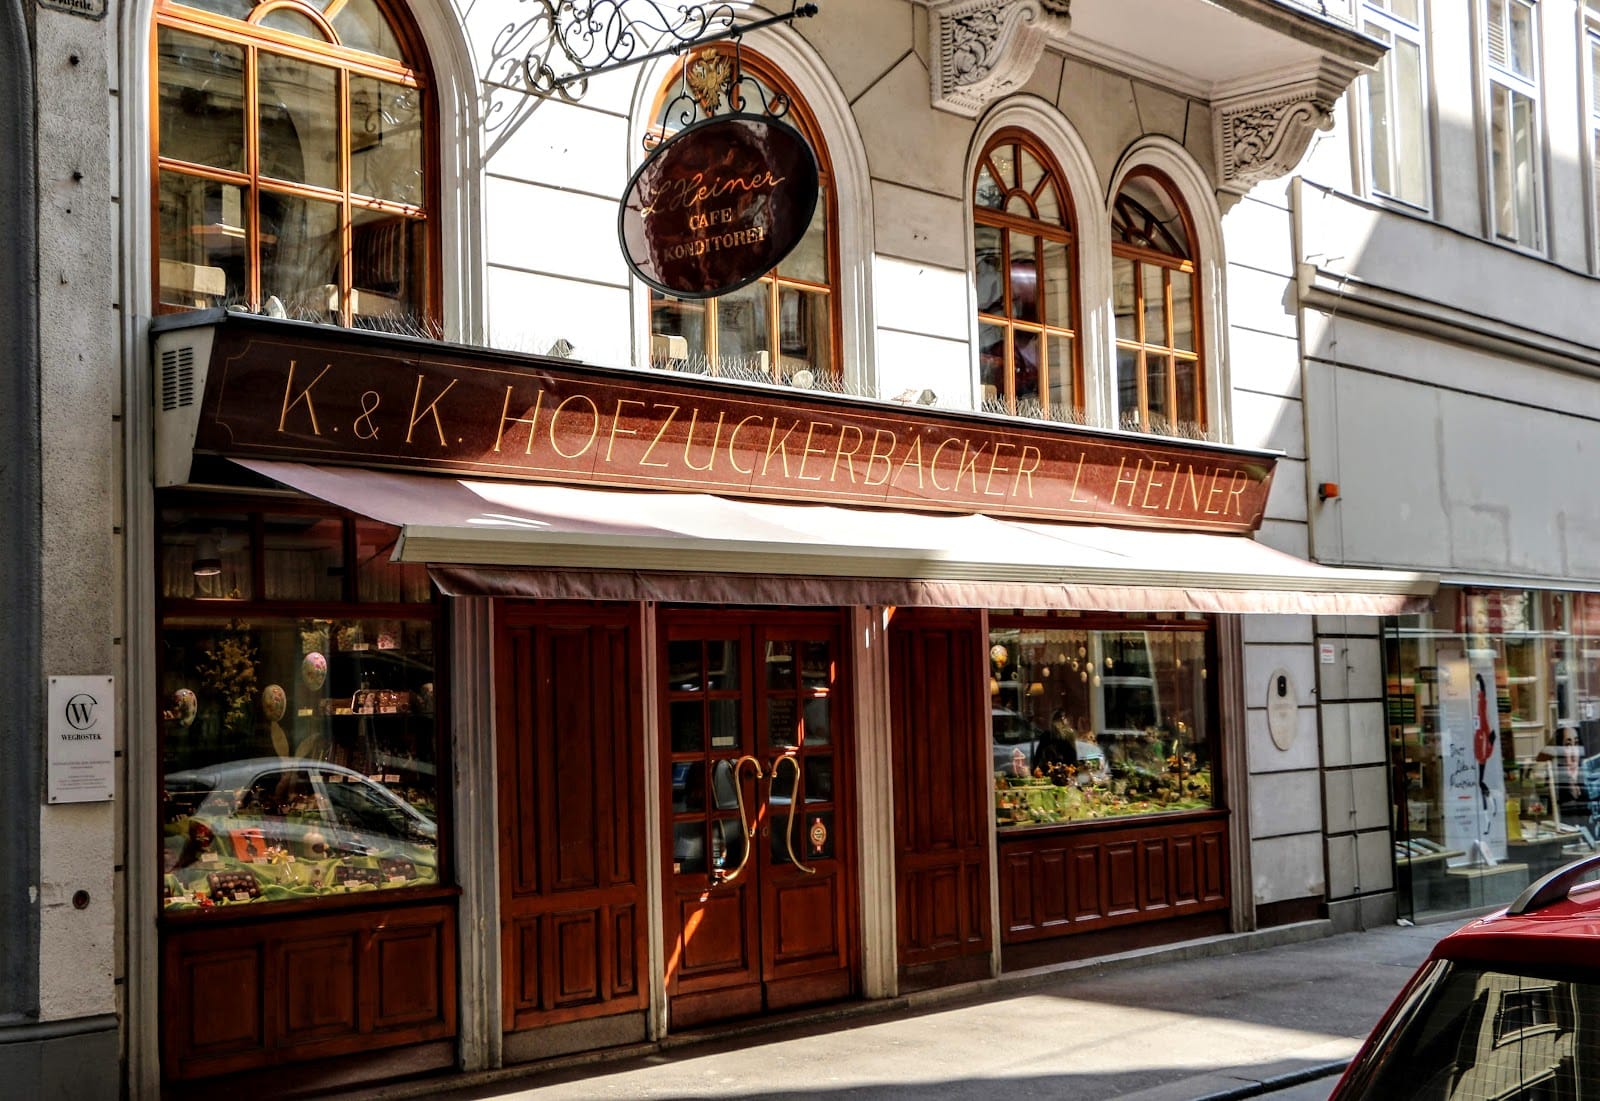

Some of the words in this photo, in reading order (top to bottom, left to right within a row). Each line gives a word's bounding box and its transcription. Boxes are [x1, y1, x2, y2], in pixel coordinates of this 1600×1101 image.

[669, 170, 786, 210] Heiner
[688, 207, 733, 231] CAFE
[664, 225, 766, 262] KONDITOREI
[277, 359, 340, 436] K.
[353, 390, 381, 441] &
[405, 374, 464, 447] K.
[493, 385, 1042, 499] HOFZUCKERBÄCKER
[1109, 456, 1249, 517] HEINER
